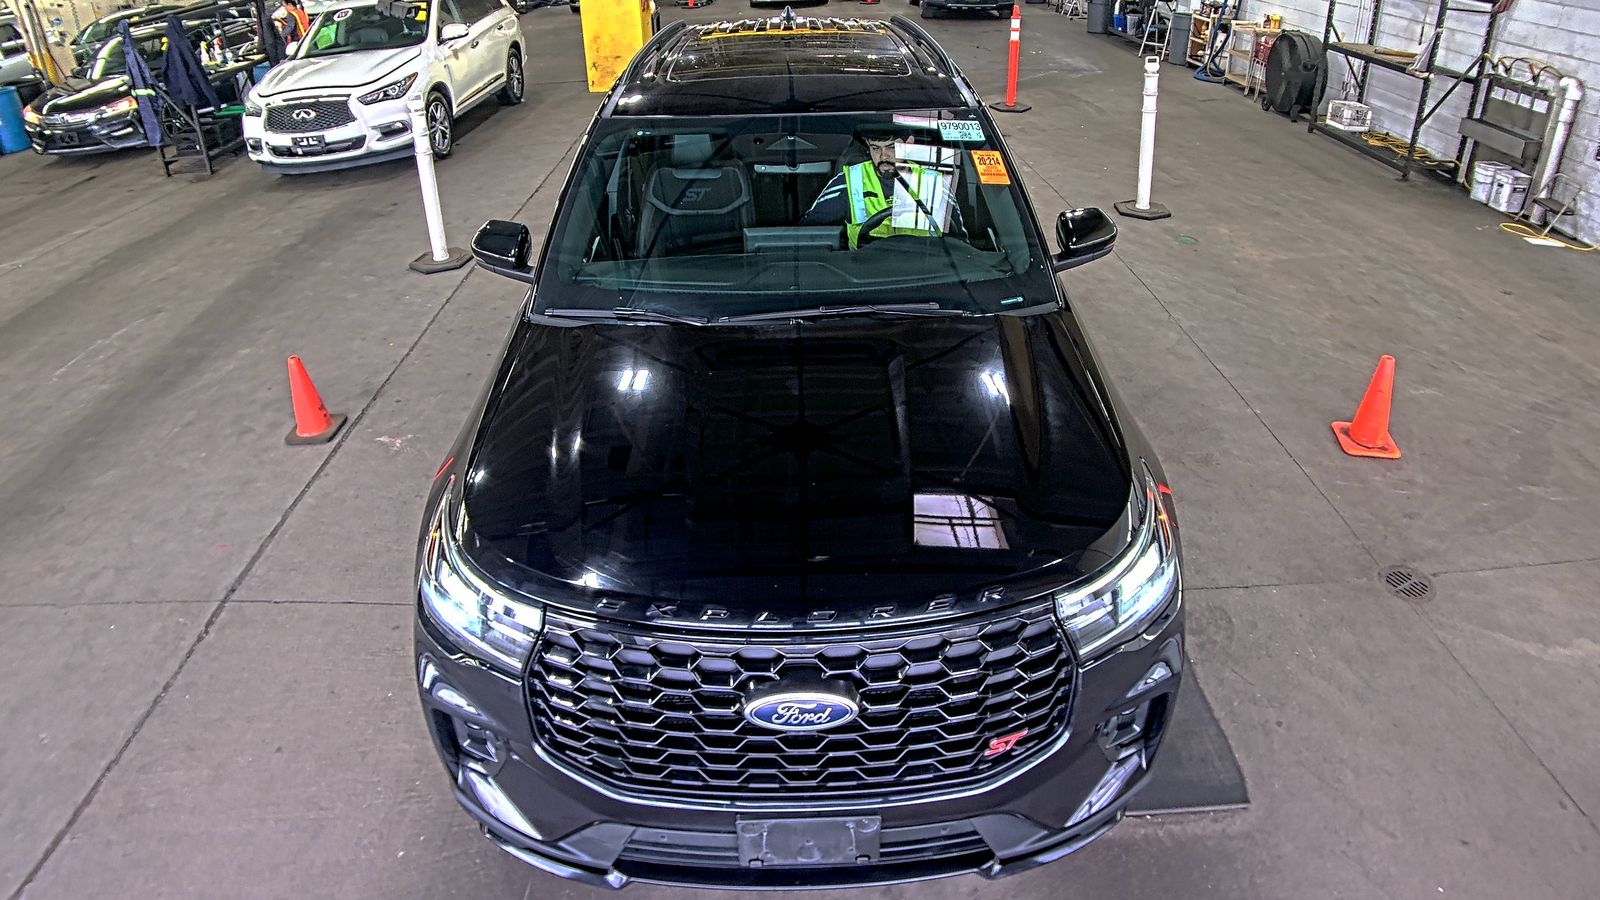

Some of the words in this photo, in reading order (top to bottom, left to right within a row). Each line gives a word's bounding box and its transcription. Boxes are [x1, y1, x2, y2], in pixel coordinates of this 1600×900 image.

[940, 121, 982, 131] 9790013
[682, 187, 712, 202] ST
[593, 586, 1007, 624] EXPLORER
[771, 702, 832, 724] Ford
[983, 728, 1029, 757] ST
